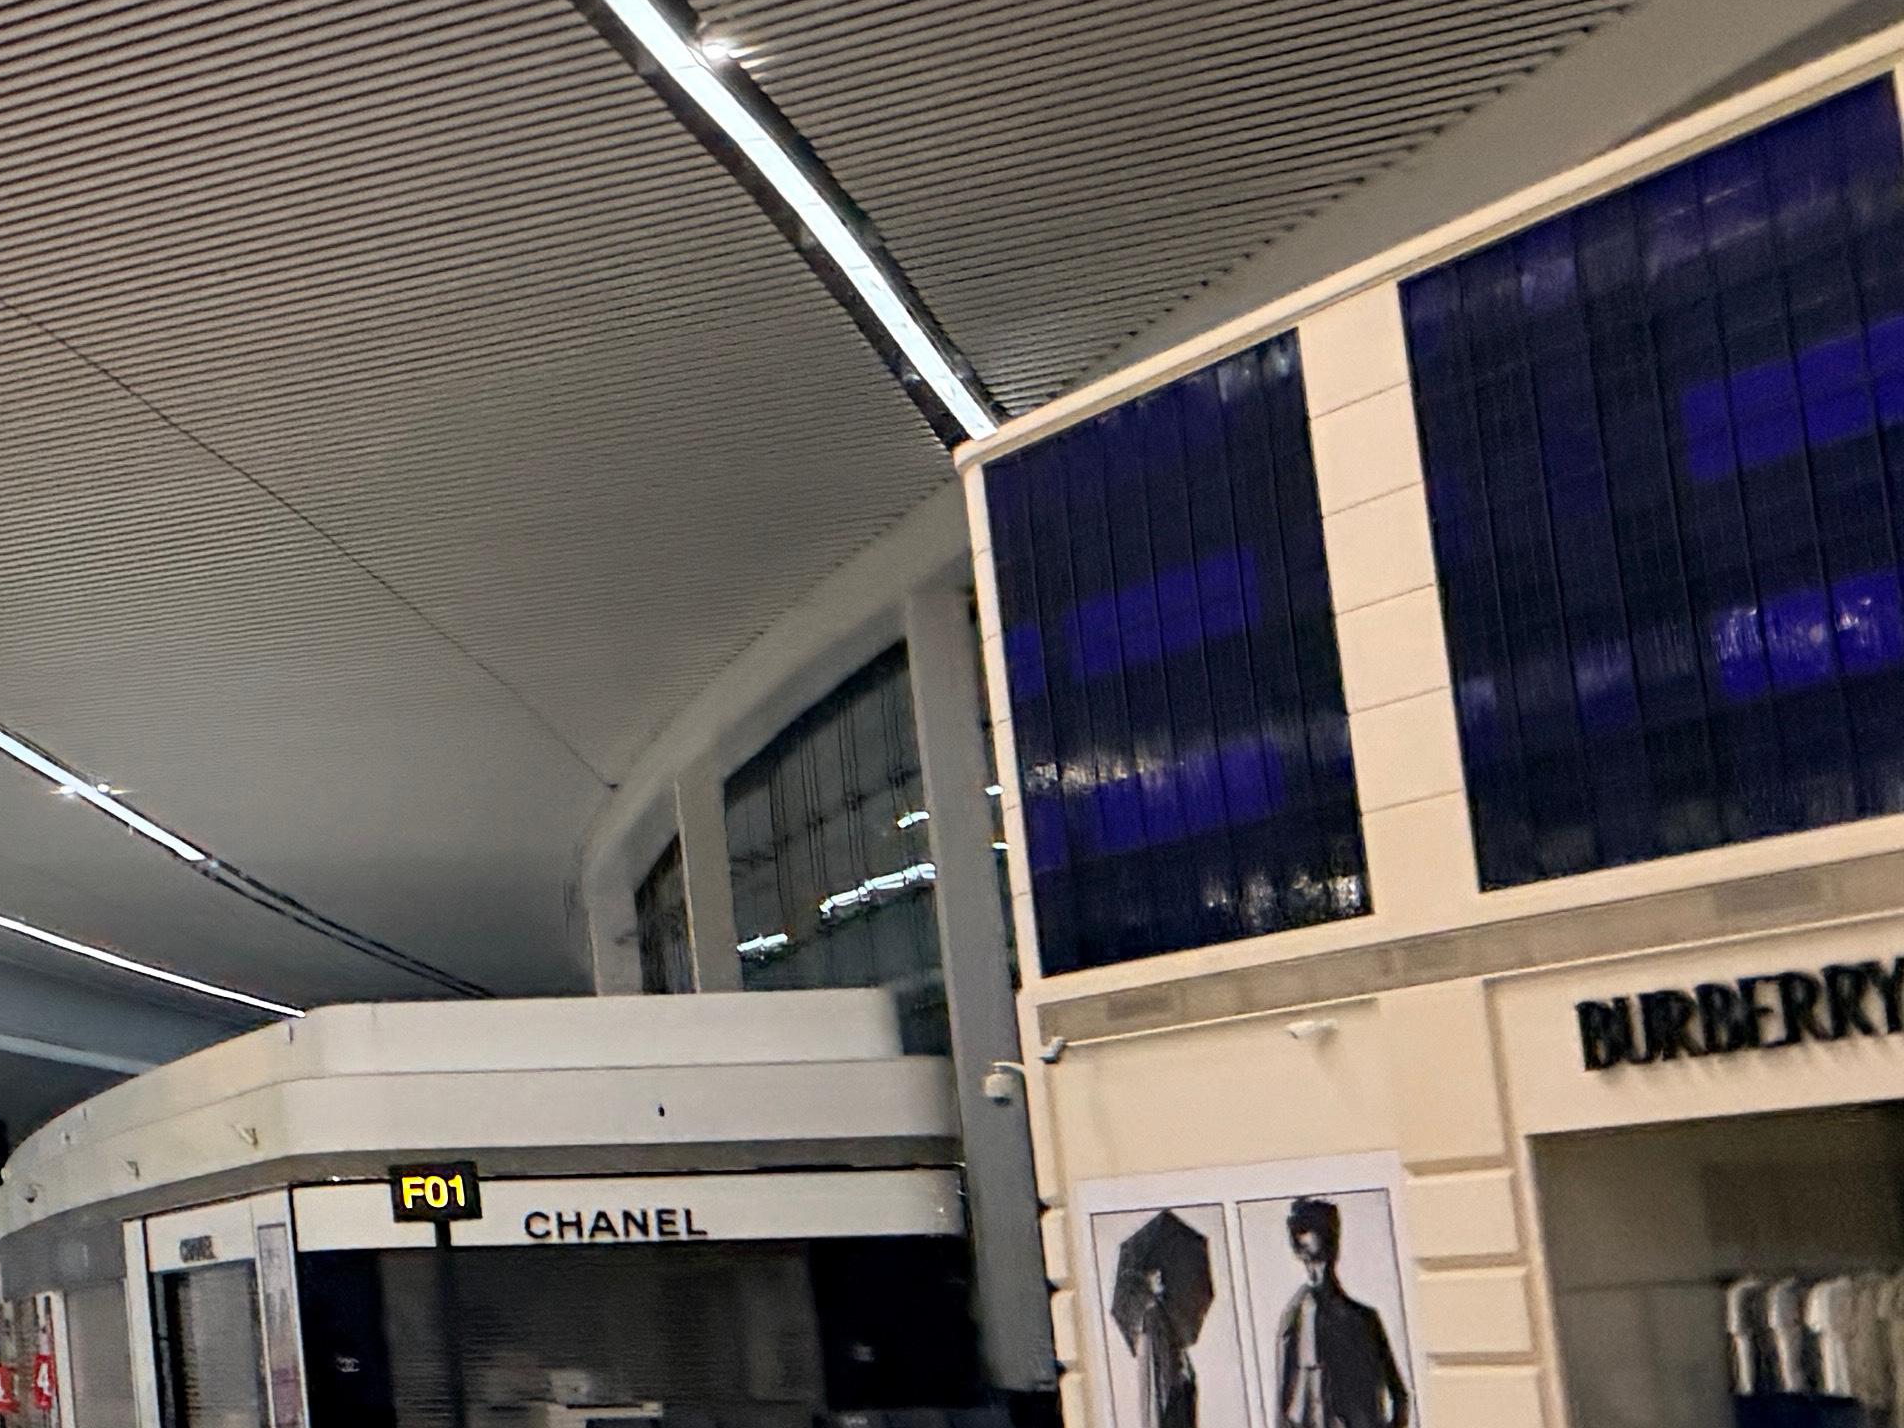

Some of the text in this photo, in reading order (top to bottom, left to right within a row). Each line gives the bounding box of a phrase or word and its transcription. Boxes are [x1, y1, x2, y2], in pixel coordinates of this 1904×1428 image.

[1575, 956, 1904, 1072] BURBERRY
[401, 1174, 466, 1210] F01
[523, 1208, 708, 1240] CHANEL
